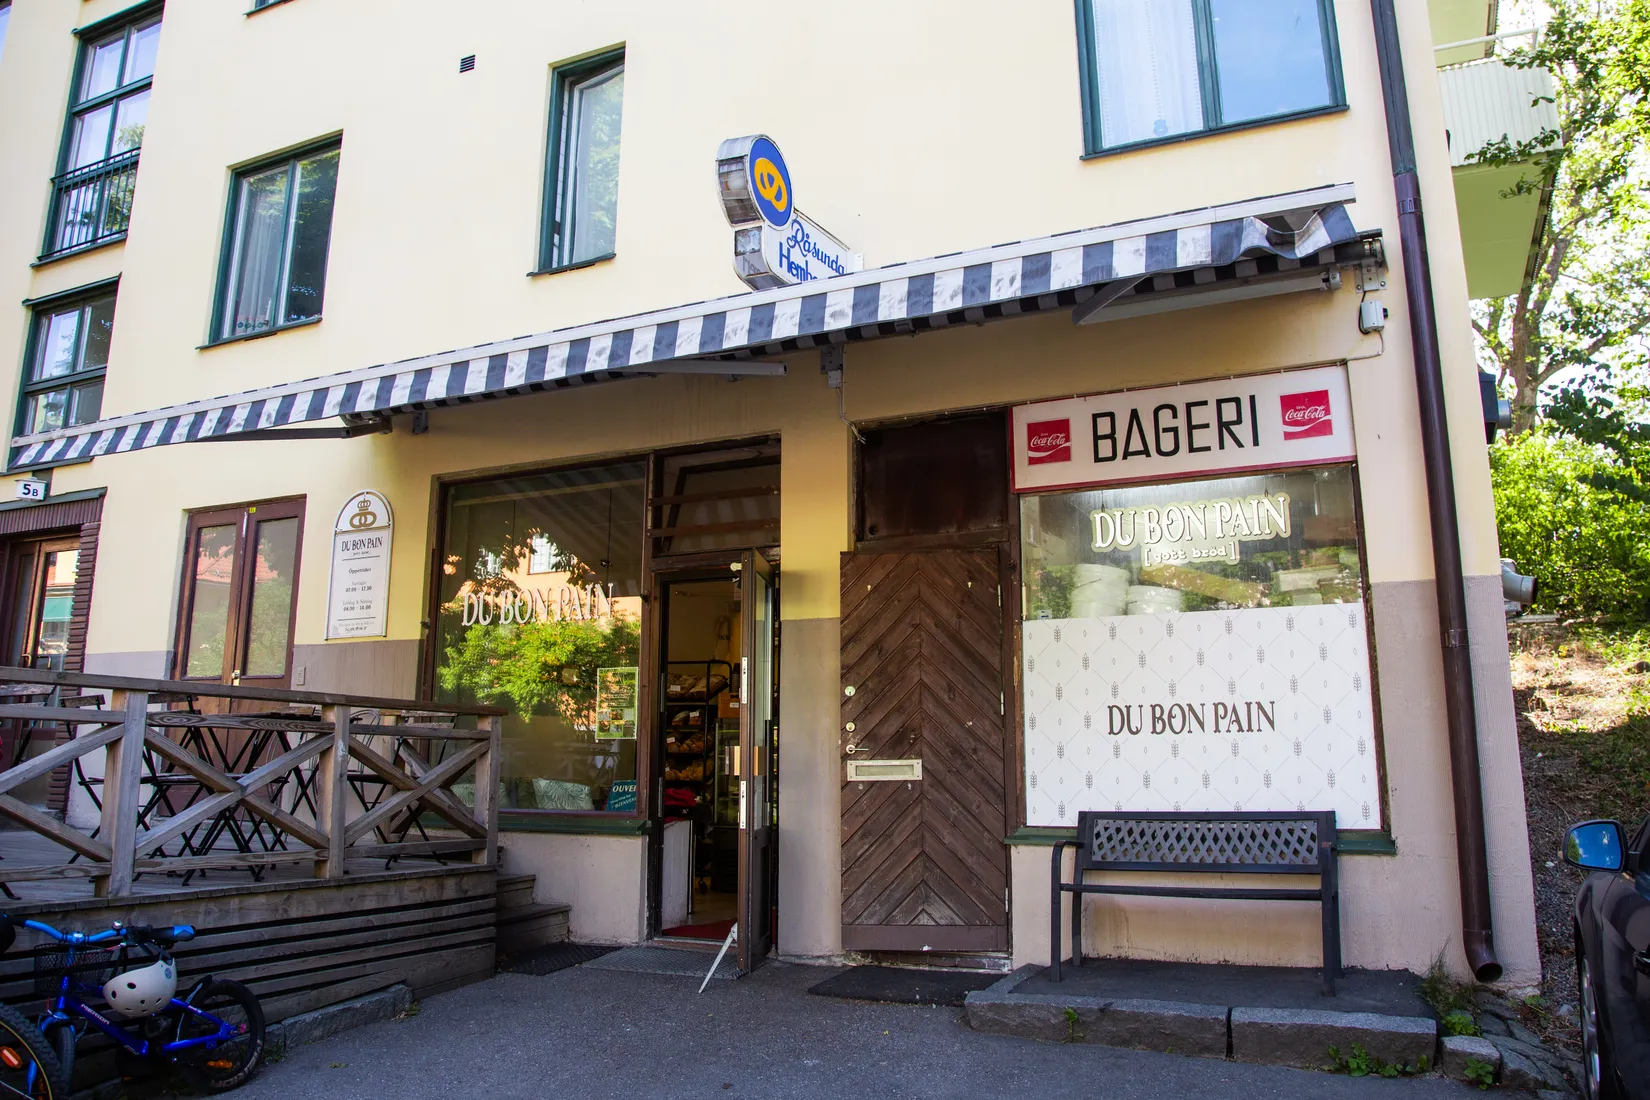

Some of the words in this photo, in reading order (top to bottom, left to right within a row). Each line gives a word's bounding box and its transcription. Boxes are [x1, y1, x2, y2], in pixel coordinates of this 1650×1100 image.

[779, 242, 818, 282] Hemb
[787, 219, 845, 274] Råsunda
[1091, 394, 1260, 463] BAGERI
[341, 540, 351, 551] DU
[352, 539, 366, 550] BON
[367, 536, 382, 548] PAIN
[1093, 509, 1136, 548] DU
[1143, 503, 1207, 544] BON
[1212, 496, 1288, 539] PAIN
[461, 591, 495, 627] DU
[499, 587, 552, 625] BON
[557, 583, 614, 622] PAIN
[1107, 704, 1144, 736] DU
[1149, 703, 1206, 735] BON
[1212, 701, 1276, 734] PAIN
